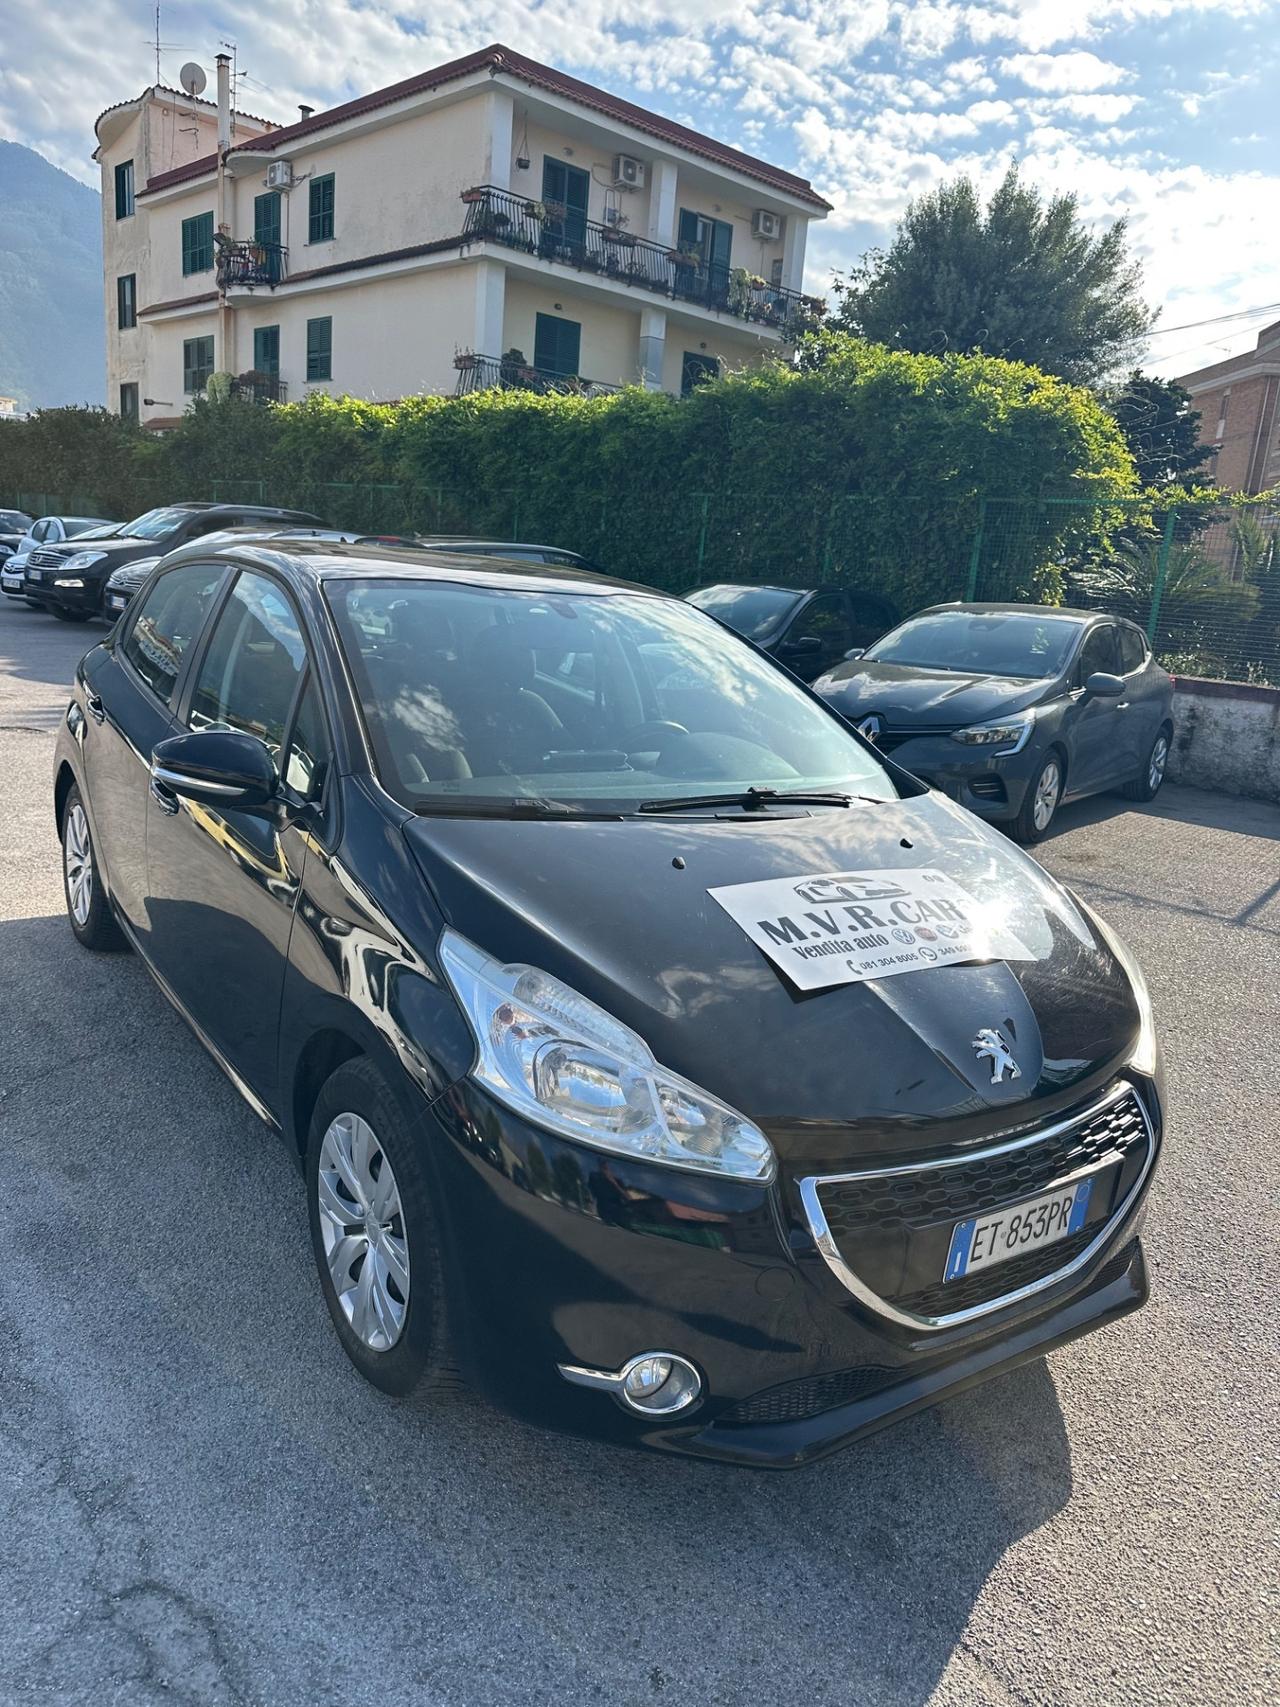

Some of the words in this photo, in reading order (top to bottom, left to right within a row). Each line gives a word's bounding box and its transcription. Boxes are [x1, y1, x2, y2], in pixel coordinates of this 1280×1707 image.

[756, 899, 970, 946] M.V.R.CAR
[791, 940, 856, 960] Vendita
[853, 933, 890, 950] auto
[860, 961, 879, 970] 081
[878, 957, 896, 967] 304
[895, 952, 919, 964] 8005
[970, 1220, 1003, 1263] ET
[1006, 1196, 1073, 1249] 853PR
